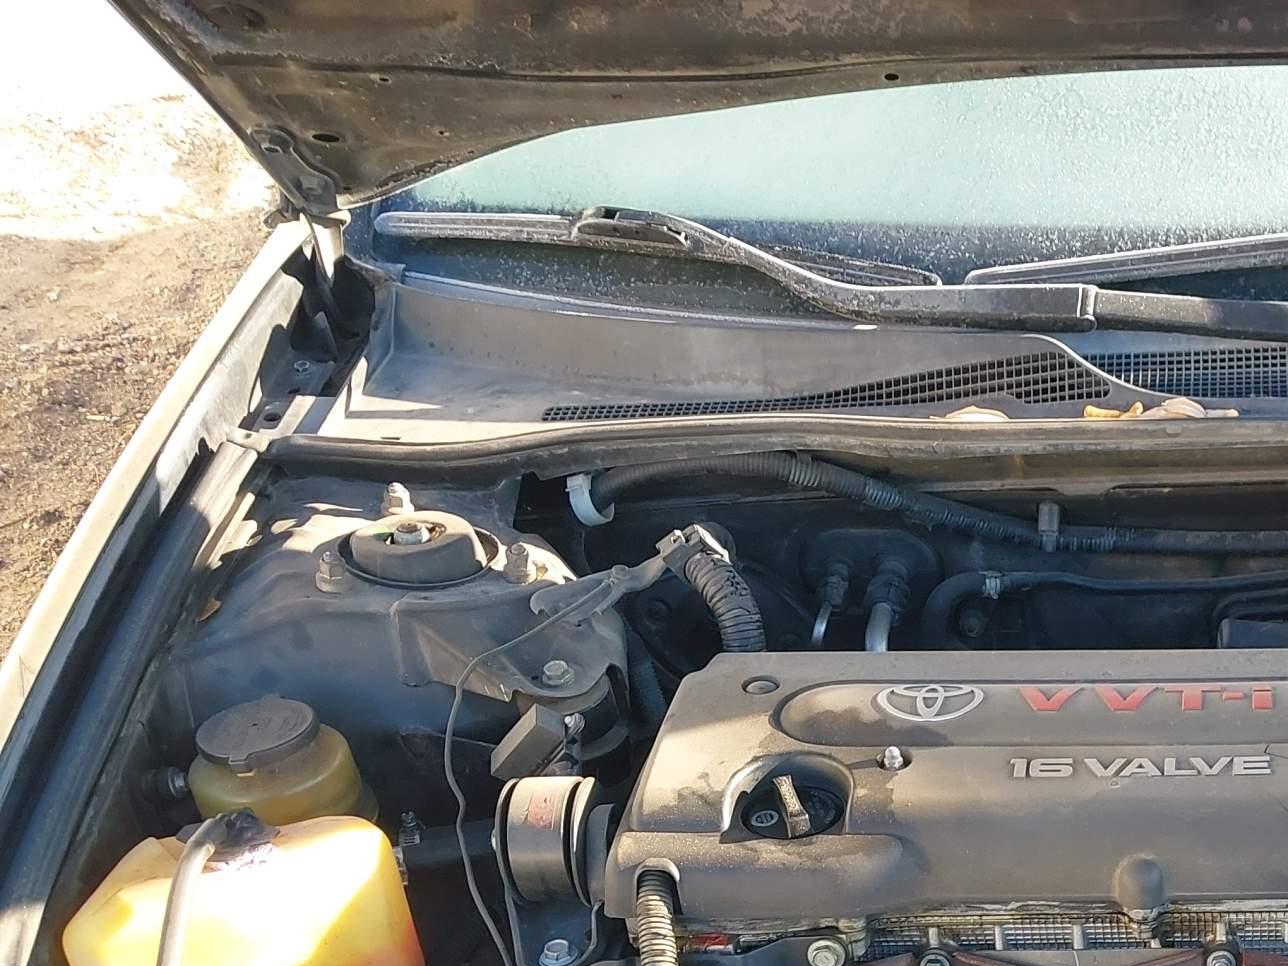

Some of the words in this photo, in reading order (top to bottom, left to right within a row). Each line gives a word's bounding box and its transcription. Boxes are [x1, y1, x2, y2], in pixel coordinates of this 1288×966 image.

[1019, 686, 1274, 713] VVT-i
[1010, 757, 1075, 779] 16
[1083, 755, 1272, 778] VALVE
